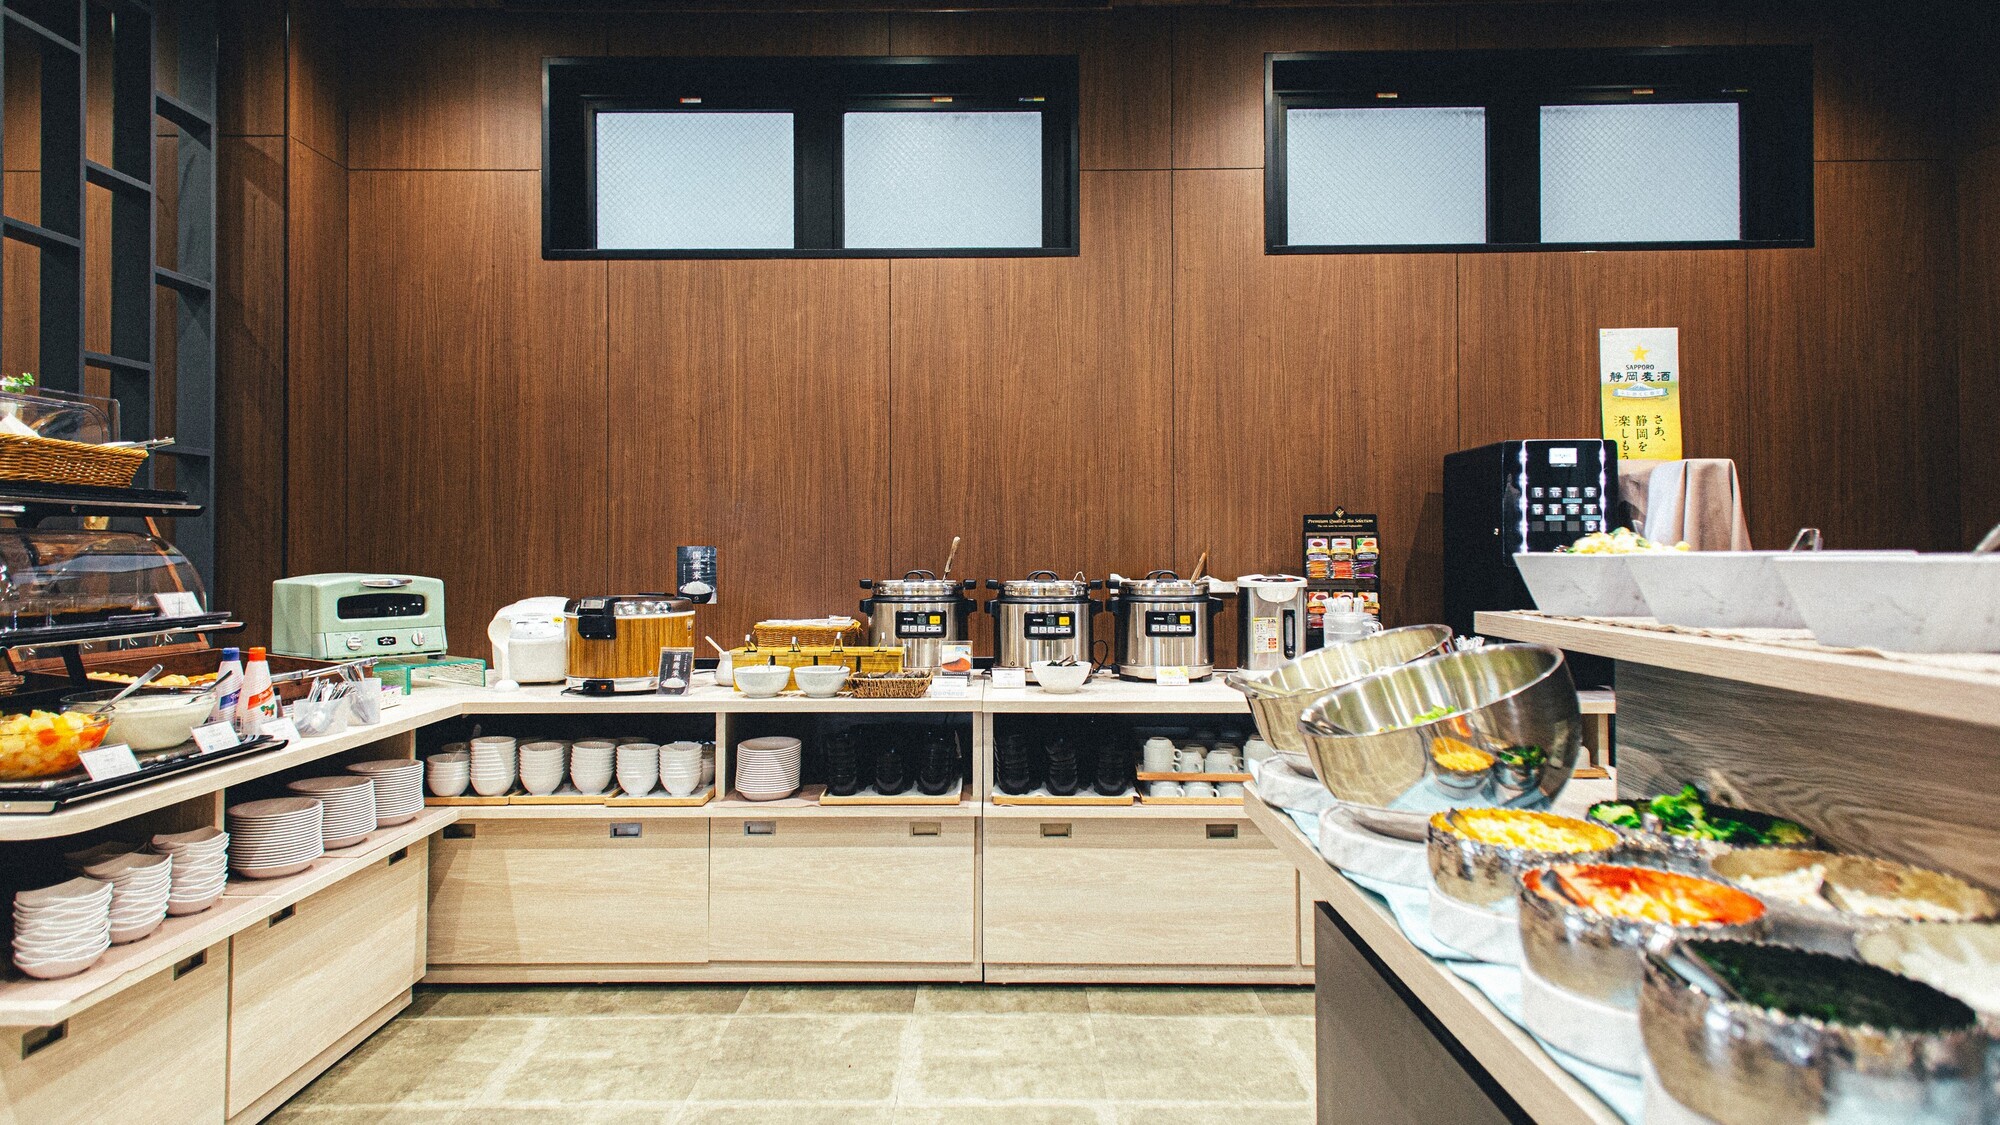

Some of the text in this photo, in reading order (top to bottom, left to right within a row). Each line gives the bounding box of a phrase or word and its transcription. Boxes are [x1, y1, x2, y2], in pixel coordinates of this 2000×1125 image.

[1609, 371, 1671, 382] 静岡麦酒
[1636, 414, 1648, 452] 静岡を
[1654, 414, 1666, 441] さあ、
